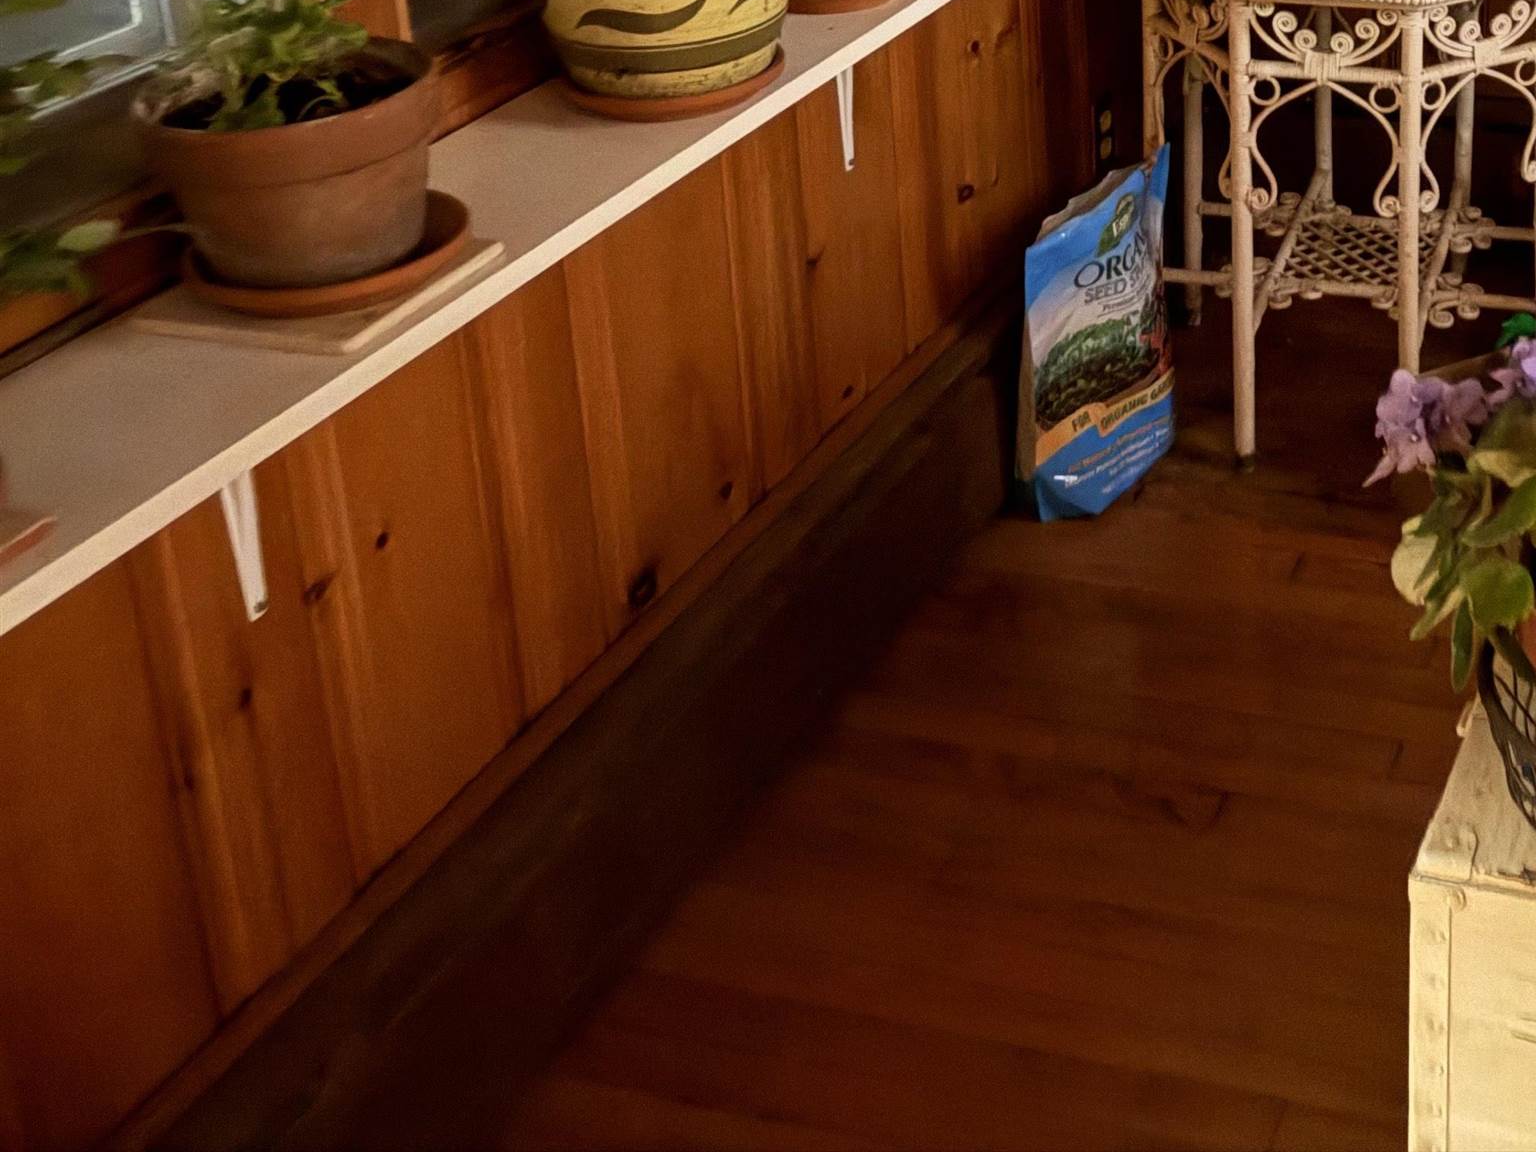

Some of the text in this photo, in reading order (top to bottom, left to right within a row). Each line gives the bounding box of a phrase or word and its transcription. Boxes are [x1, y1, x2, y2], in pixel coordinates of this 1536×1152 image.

[1084, 278, 1127, 305] SEED
[1071, 410, 1091, 433] FOR
[1101, 392, 1149, 429] ORGANIC
